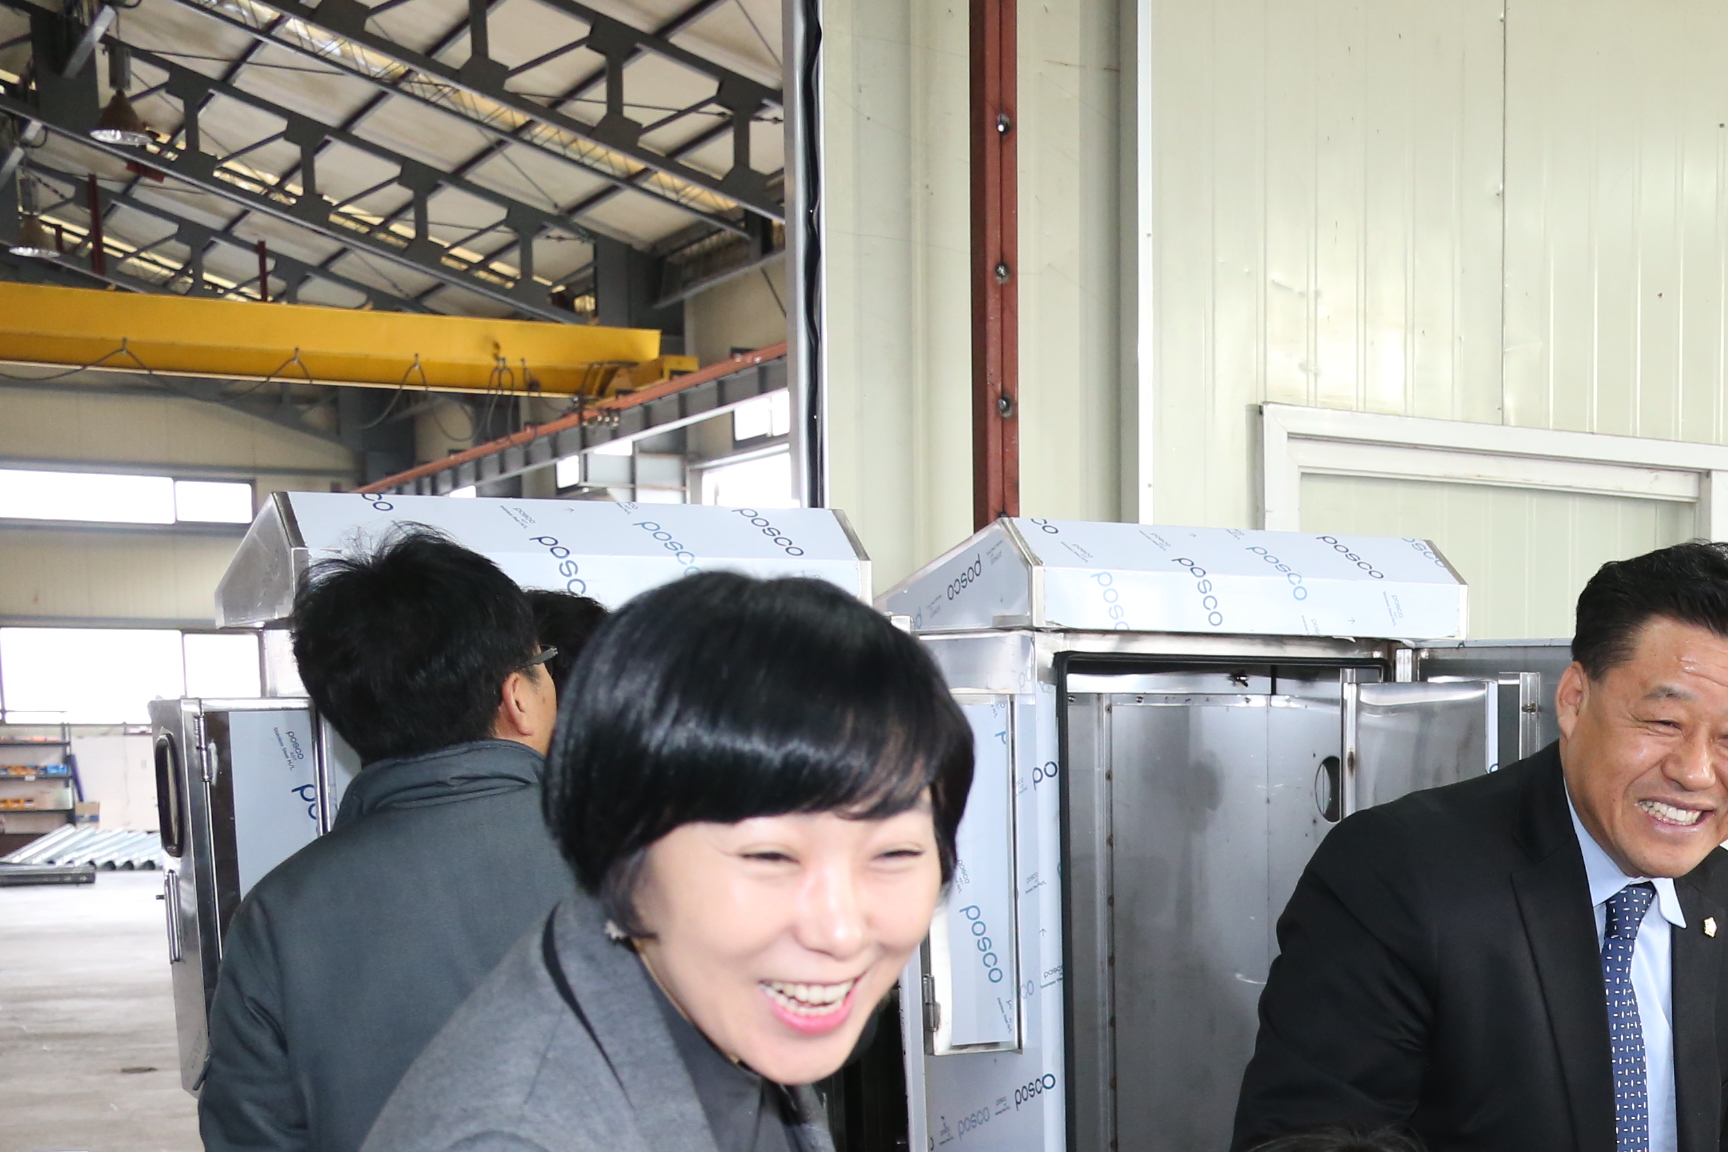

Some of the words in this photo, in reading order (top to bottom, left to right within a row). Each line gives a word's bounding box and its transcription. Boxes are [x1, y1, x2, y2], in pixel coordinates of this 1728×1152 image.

[731, 508, 804, 557] posco
[1401, 537, 1447, 568] osco
[529, 535, 587, 596] posc
[946, 553, 982, 601] posco
[1245, 546, 1307, 601] posco
[1316, 535, 1384, 580] posco
[1090, 571, 1130, 630] posc
[1171, 557, 1223, 626] posco
[286, 730, 304, 760] posco
[959, 904, 1003, 983] posco
[1014, 1073, 1056, 1111] posco
[957, 1106, 990, 1142] posco
